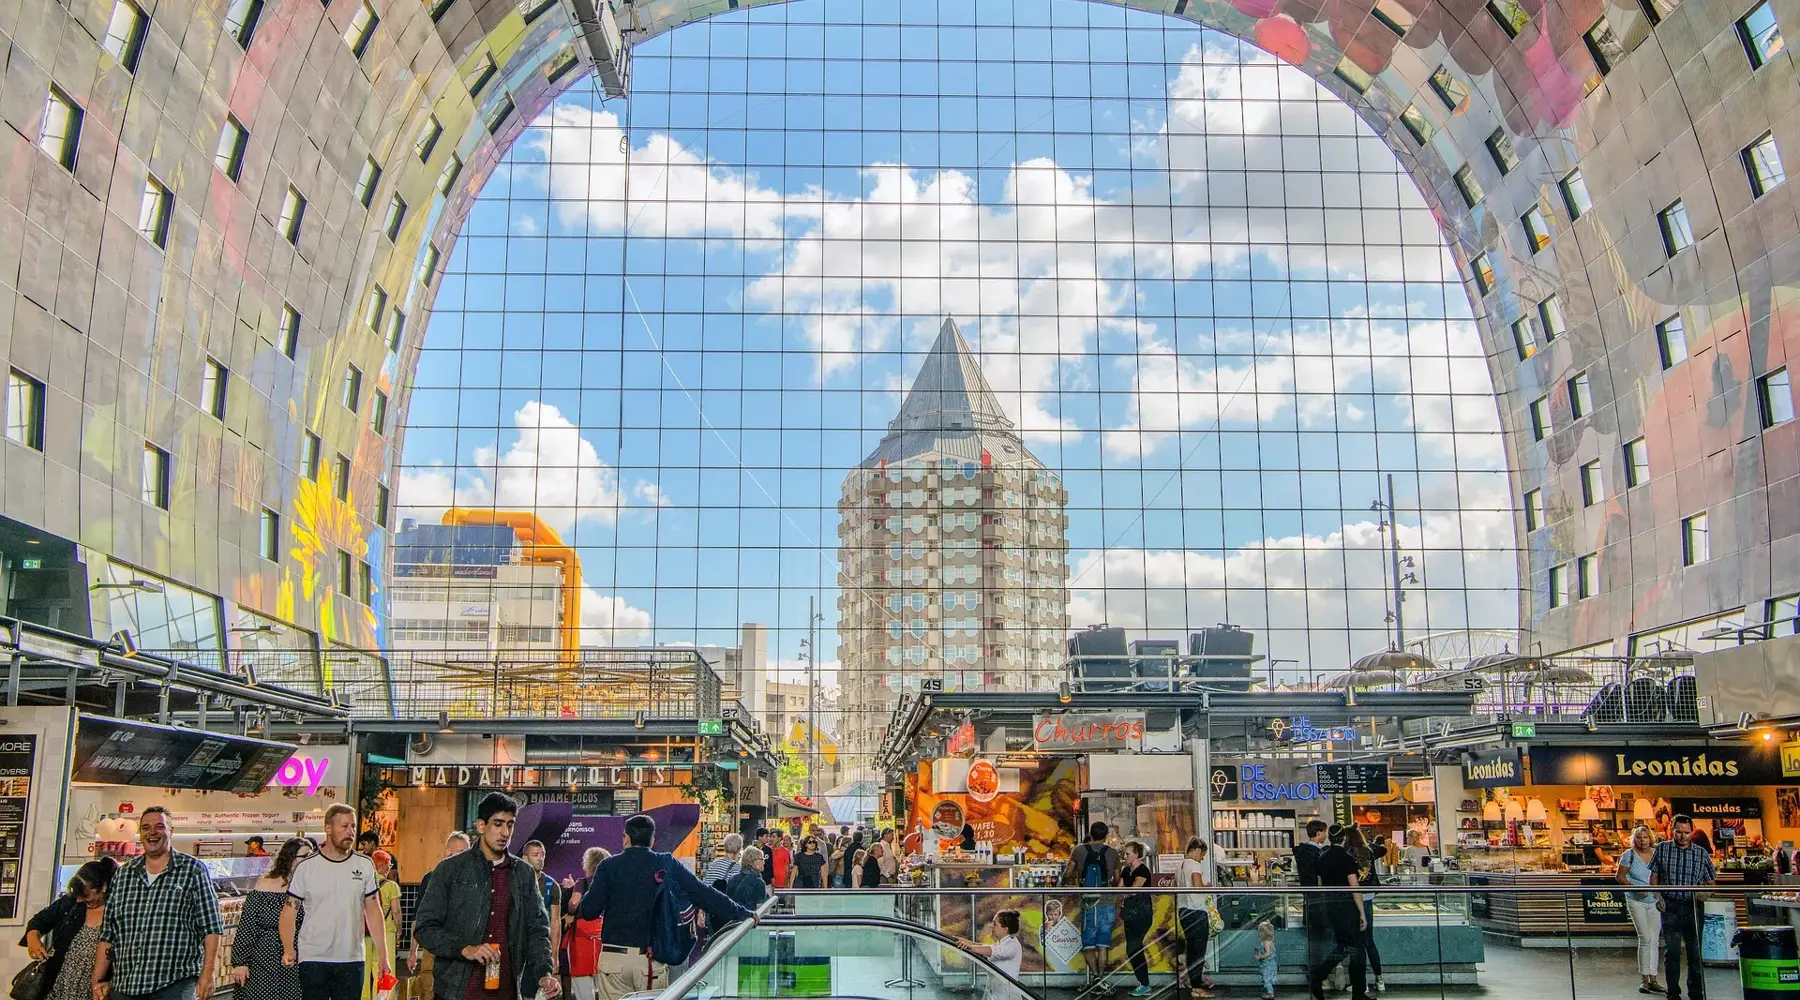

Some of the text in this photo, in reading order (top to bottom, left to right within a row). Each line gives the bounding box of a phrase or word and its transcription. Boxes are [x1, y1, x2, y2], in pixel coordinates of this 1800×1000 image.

[923, 680, 941, 690] 49
[722, 709, 738, 718] 27
[1035, 716, 1145, 743] Churros
[1467, 756, 1515, 780] Leonidas
[1615, 753, 1739, 777] Leonidas
[411, 765, 666, 786] MADAME COCOS
[1241, 764, 1265, 781] DE
[531, 793, 598, 804] MADAME COCOS
[882, 793, 890, 815] TEA
[1693, 803, 1741, 813] Leonidas
[972, 822, 996, 831] WAFEL
[974, 831, 995, 840] 1.30
[1587, 899, 1623, 908] Leonidas
